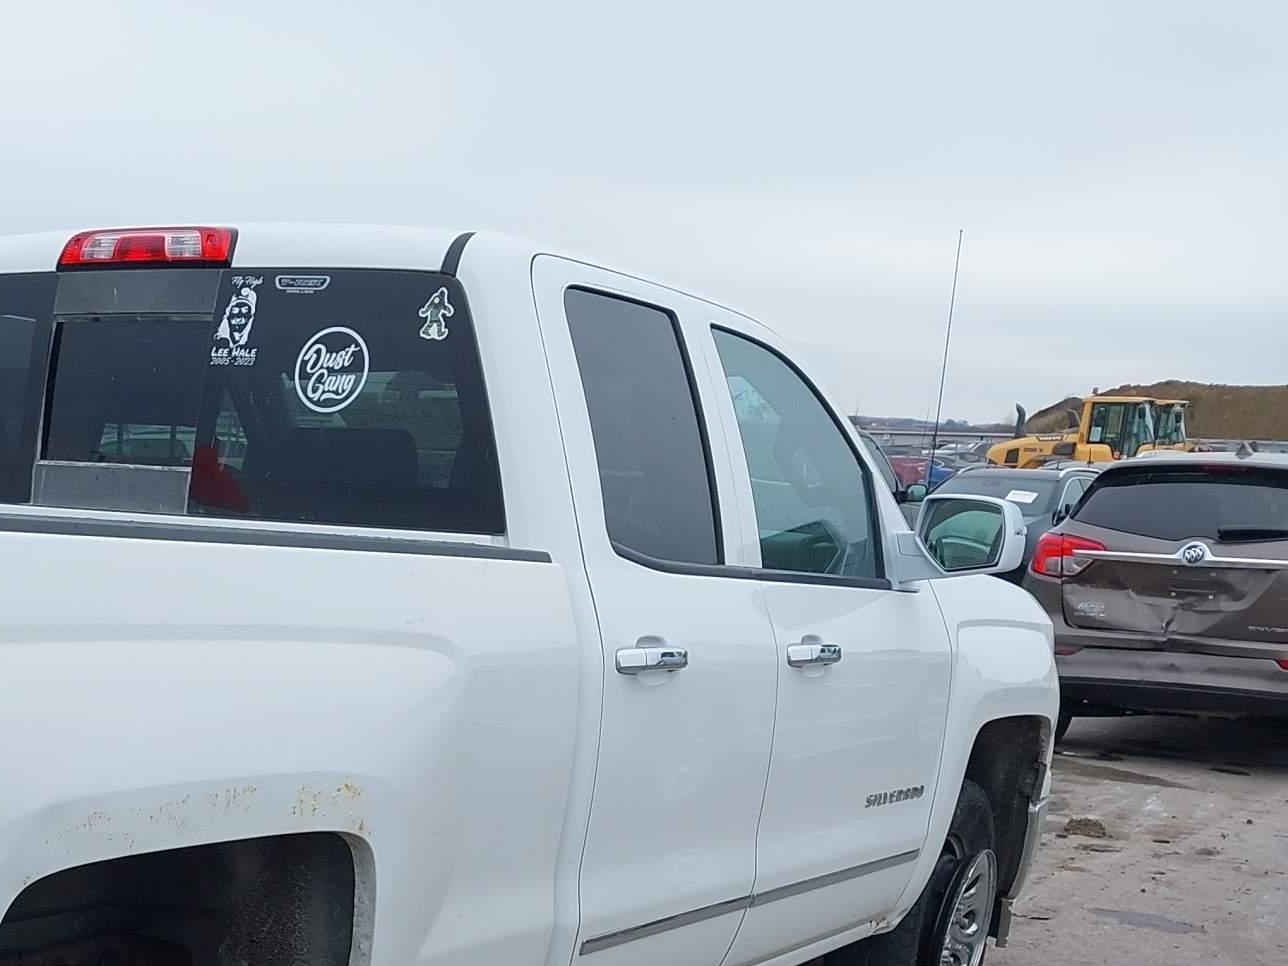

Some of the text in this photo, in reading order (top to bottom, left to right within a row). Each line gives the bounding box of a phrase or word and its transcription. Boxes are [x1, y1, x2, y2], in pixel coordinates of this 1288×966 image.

[211, 346, 257, 357] LEE HALE
[303, 343, 361, 373] Dust
[307, 368, 356, 402] Gang
[864, 785, 924, 808] SILVERADO
